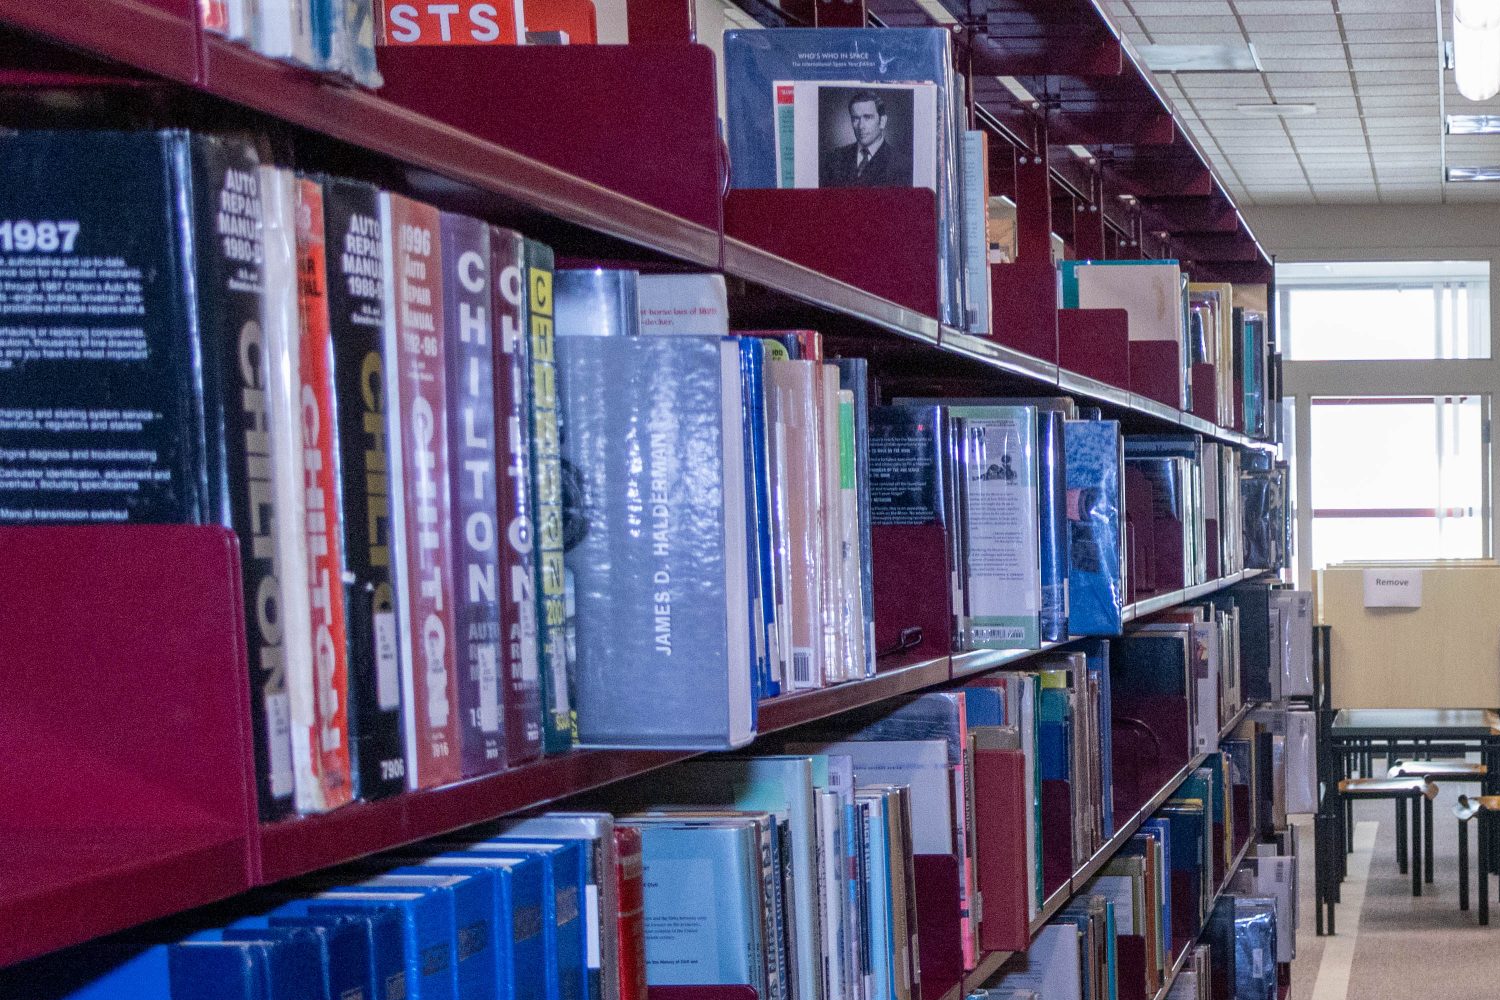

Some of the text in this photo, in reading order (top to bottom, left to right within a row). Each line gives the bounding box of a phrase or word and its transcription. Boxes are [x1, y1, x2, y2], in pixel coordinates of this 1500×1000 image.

[390, 3, 500, 43] STS
[798, 52, 869, 60] WHO'S WHO IN SPACE
[226, 167, 257, 199] AUTO
[0, 219, 80, 251] 1987
[351, 213, 381, 238] AUTO
[458, 252, 496, 602] CHILTON
[302, 384, 341, 752] CHILTON
[1375, 578, 1409, 586] Remove
[653, 590, 672, 656] JAMES
